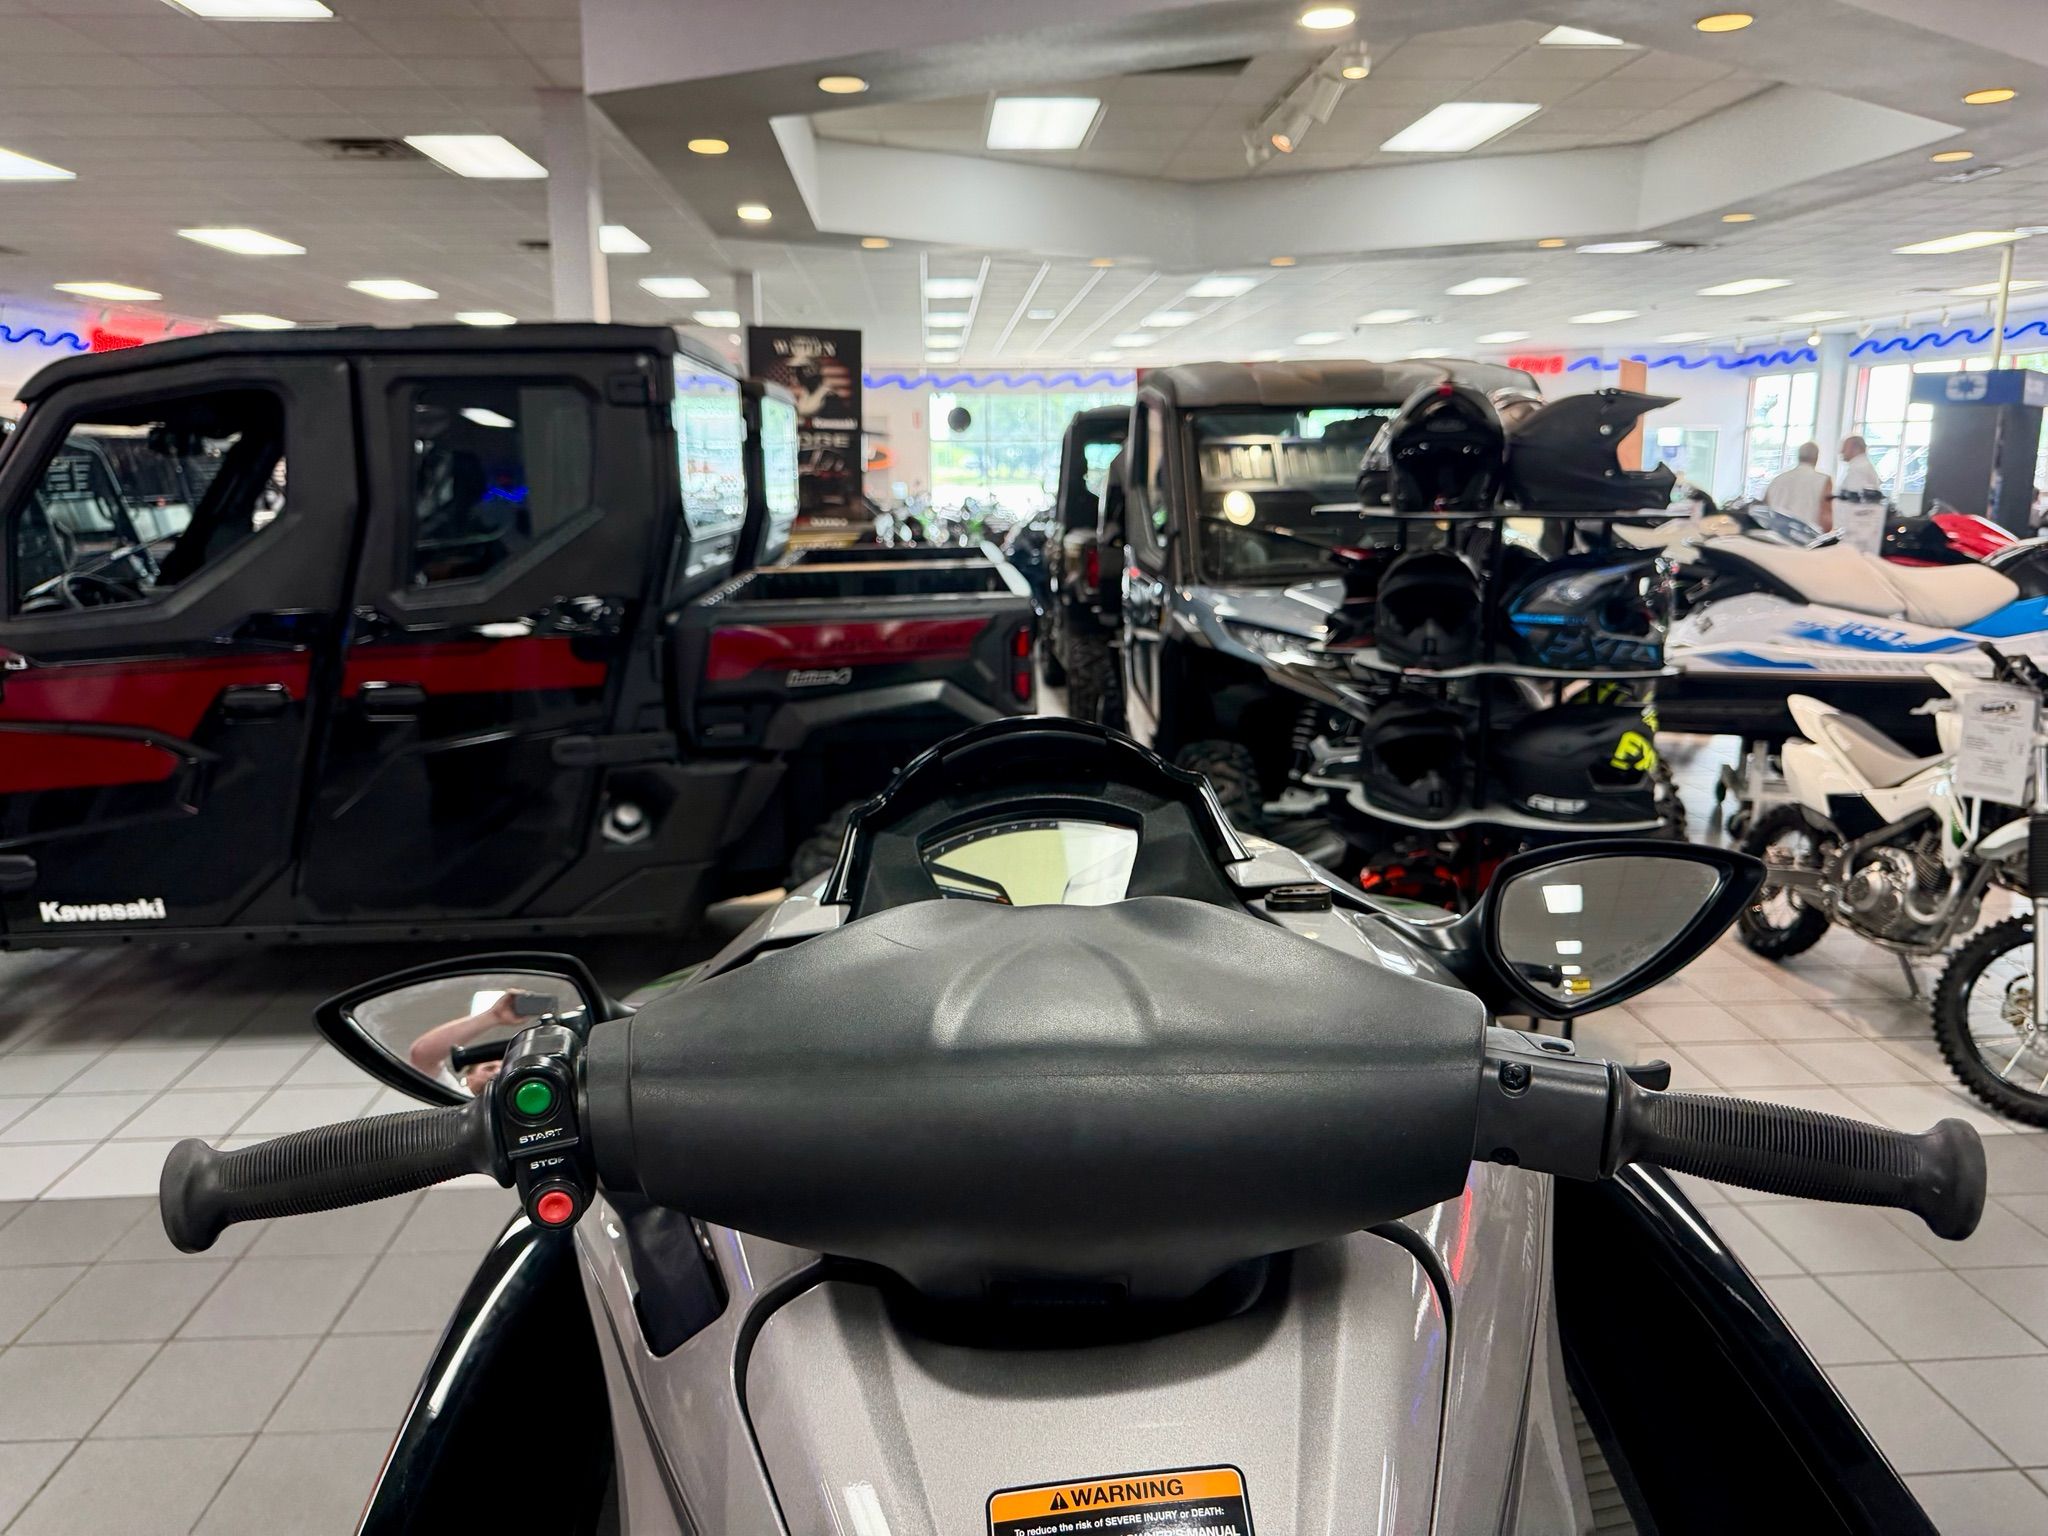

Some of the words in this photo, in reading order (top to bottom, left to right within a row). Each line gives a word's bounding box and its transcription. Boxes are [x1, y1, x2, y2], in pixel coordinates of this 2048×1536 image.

[38, 897, 167, 922] Kawasaki
[518, 1127, 563, 1144] START
[1070, 1478, 1184, 1507] WARNING
[1027, 1525, 1058, 1536] reduce
[1059, 1522, 1074, 1532] the
[1075, 1520, 1092, 1531] risk
[1094, 1517, 1103, 1528] of
[1105, 1513, 1142, 1527] SEVERE
[1143, 1510, 1178, 1522] INJURY
[1180, 1510, 1189, 1519] or
[1191, 1506, 1225, 1518] DEATH:
[1185, 1524, 1241, 1536] MANUAL
